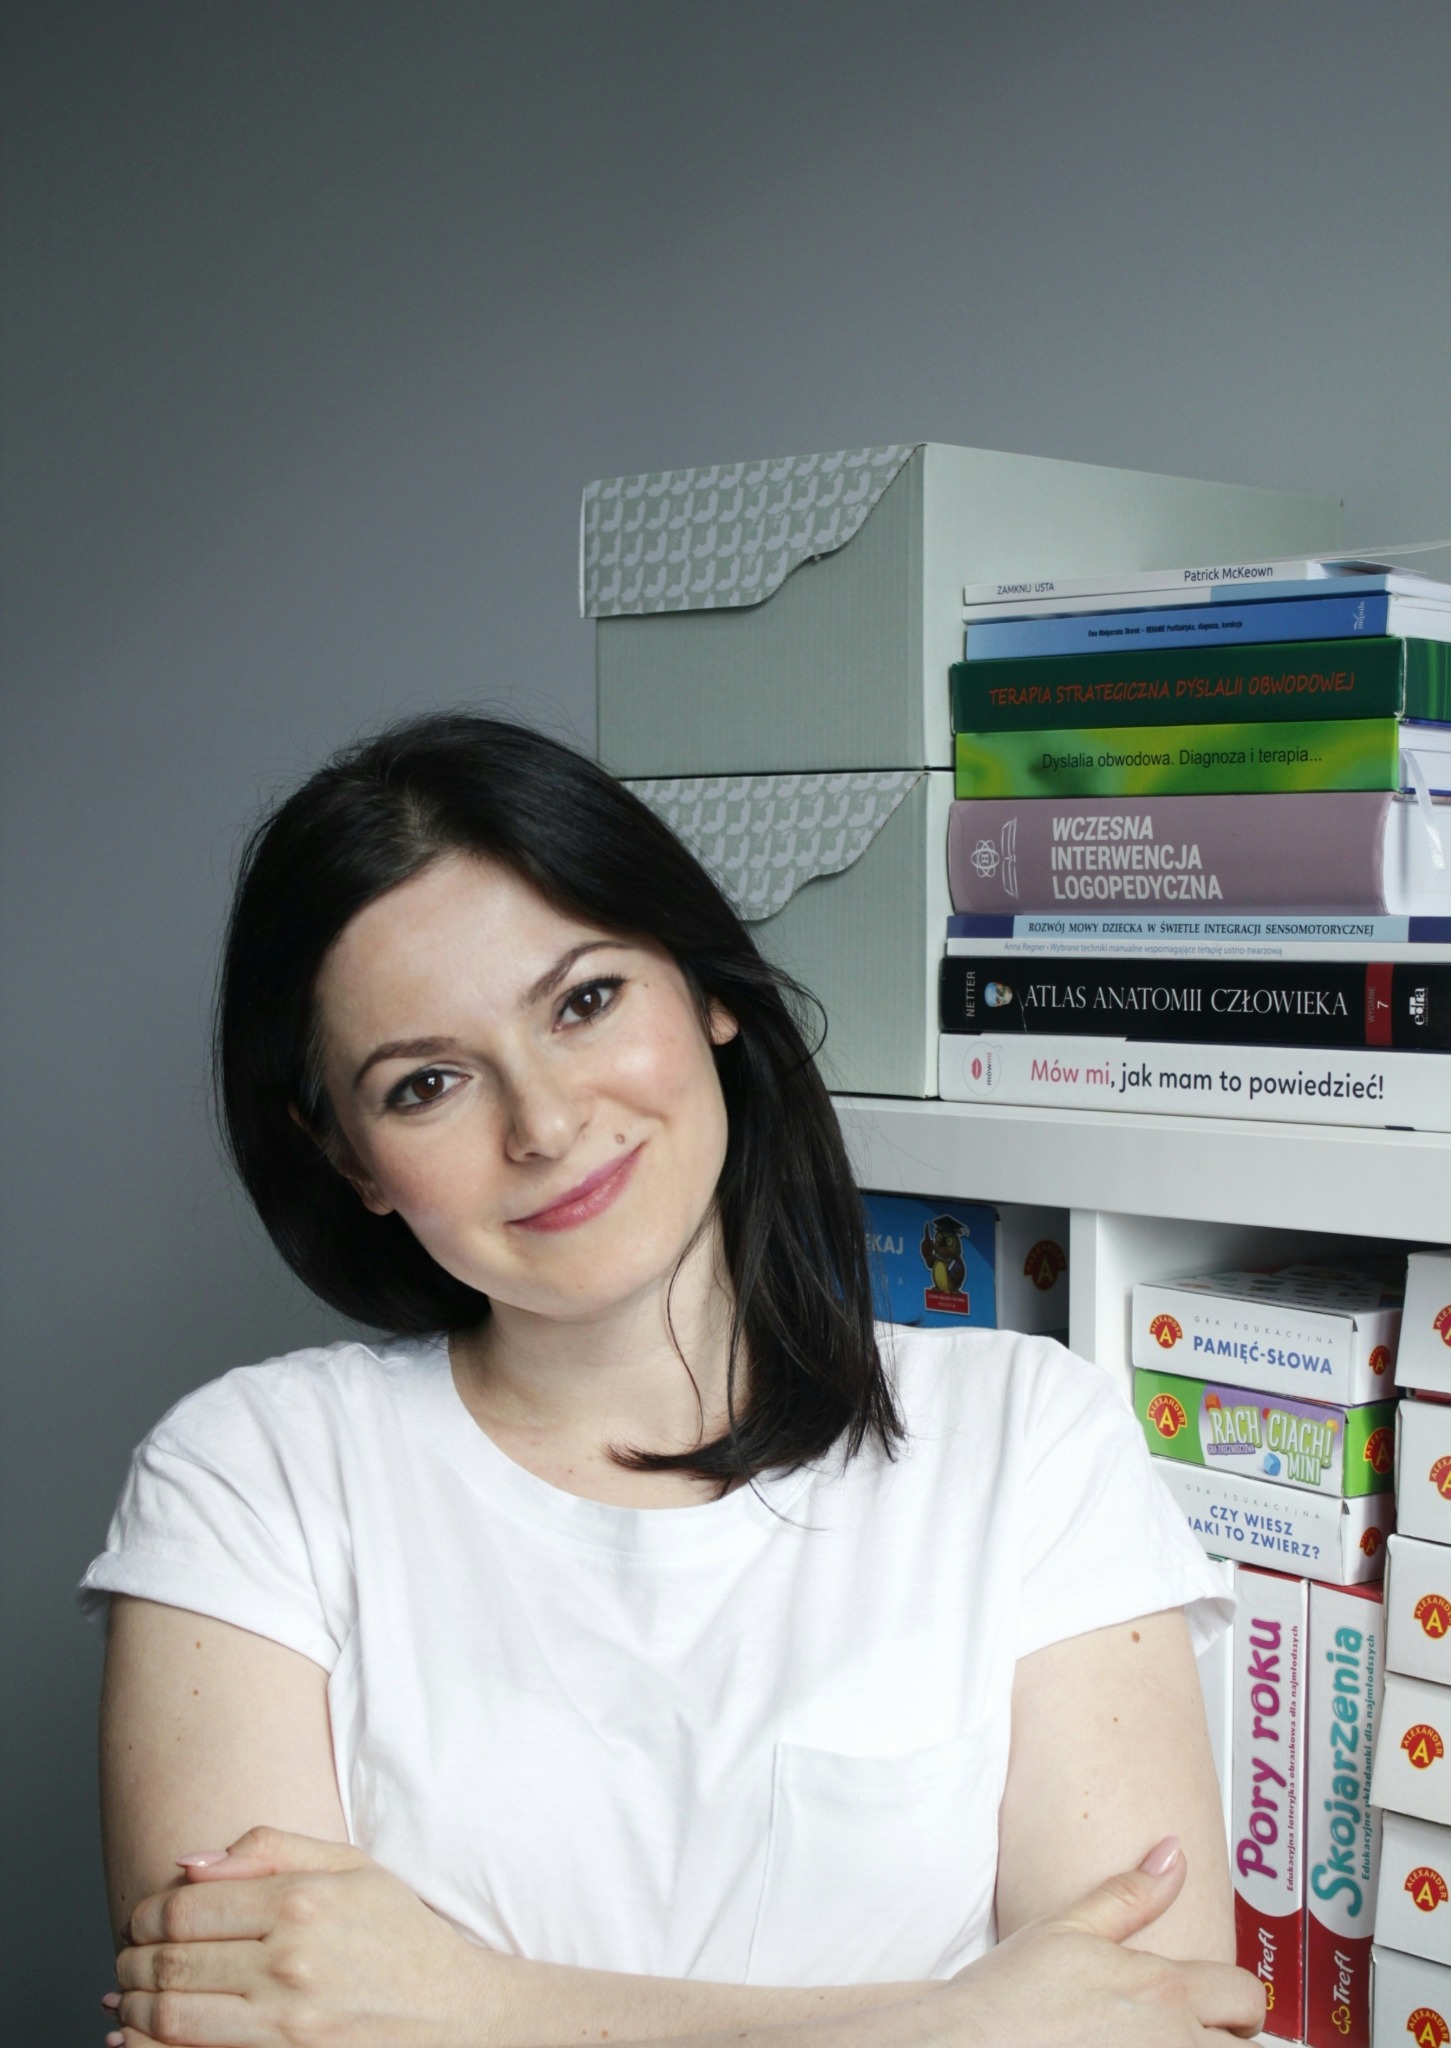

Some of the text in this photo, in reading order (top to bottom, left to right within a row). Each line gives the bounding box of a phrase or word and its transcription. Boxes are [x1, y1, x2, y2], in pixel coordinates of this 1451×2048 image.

[997, 582, 1055, 595] ZAMKNIJ USTA
[1184, 566, 1273, 582] Patrick McKeown
[989, 672, 1355, 705] TERAPIA STRATEGICZNA DYSLALII OBWODOWEJ
[1042, 746, 1322, 772] Dyslalia obwodowa. Diagnoza i terapia...
[1052, 815, 1154, 842] WCZESNA
[1051, 844, 1203, 871] INTERWENCJA
[1052, 874, 1224, 900] LOGOPEDYCZNA
[1028, 920, 1374, 937] ROZWÓJ MOWY DZIECKA W ŚWIETLE INTEGRACJI SENSOMOTORYCZNEJ
[1004, 942, 1283, 957] Anna Regner Wybrane techniki manualne wspomagające terapię ustno-twarzową
[966, 971, 976, 1017] NETTER
[1024, 984, 1349, 1016] ATLAS ANATOMII CZŁOWIEKA
[1368, 985, 1376, 1023] WYDANIE
[1377, 1000, 1389, 1009] 7
[1409, 987, 1426, 1026] edra
[1030, 1059, 1384, 1100] Mów mi, jak mam to powiedzieć!
[1150, 1316, 1182, 1339] ALEXANDER
[1159, 1325, 1174, 1345] A
[1194, 1315, 1334, 1345] GRA EDUKACYJNA
[1193, 1335, 1333, 1375] PAMIĘĆ-SŁOWA
[1149, 1396, 1185, 1426] ALEXANDER
[1159, 1411, 1176, 1431] A
[1209, 1408, 1333, 1466] RACH CIACH!
[1288, 1453, 1321, 1485] MINI
[1185, 1484, 1320, 1520] GRA EDUKACYJNA
[1209, 1505, 1293, 1536] CZY WIESZ
[1225, 1526, 1245, 1542] TO
[1251, 1531, 1320, 1560] ZWIERZ?
[1425, 1608, 1443, 1634] A
[1289, 1625, 1300, 1698] najmłodszych
[1365, 1634, 1376, 1719] najmłodszych
[1364, 1721, 1373, 1742] dla
[1403, 1726, 1443, 1755] ALEXANDER
[1236, 1618, 1287, 1879] Pory roku
[1288, 1720, 1296, 1779] obrazkowa
[1411, 1738, 1430, 1764] A
[1311, 1626, 1363, 1917] Skojarzenia
[1288, 1781, 1297, 1830] loteryjka
[1362, 1811, 1373, 1881] Edukacyjne
[1287, 1832, 1296, 1892] Edukacyjna
[1406, 1868, 1447, 1899] ALEXANDER
[1416, 1881, 1435, 1908] A
[1257, 1927, 1278, 1981] Trefl
[1333, 1949, 1355, 2005] Trefl
[1408, 2009, 1449, 2040] ALEXANDER
[1418, 2021, 1437, 2048] A
